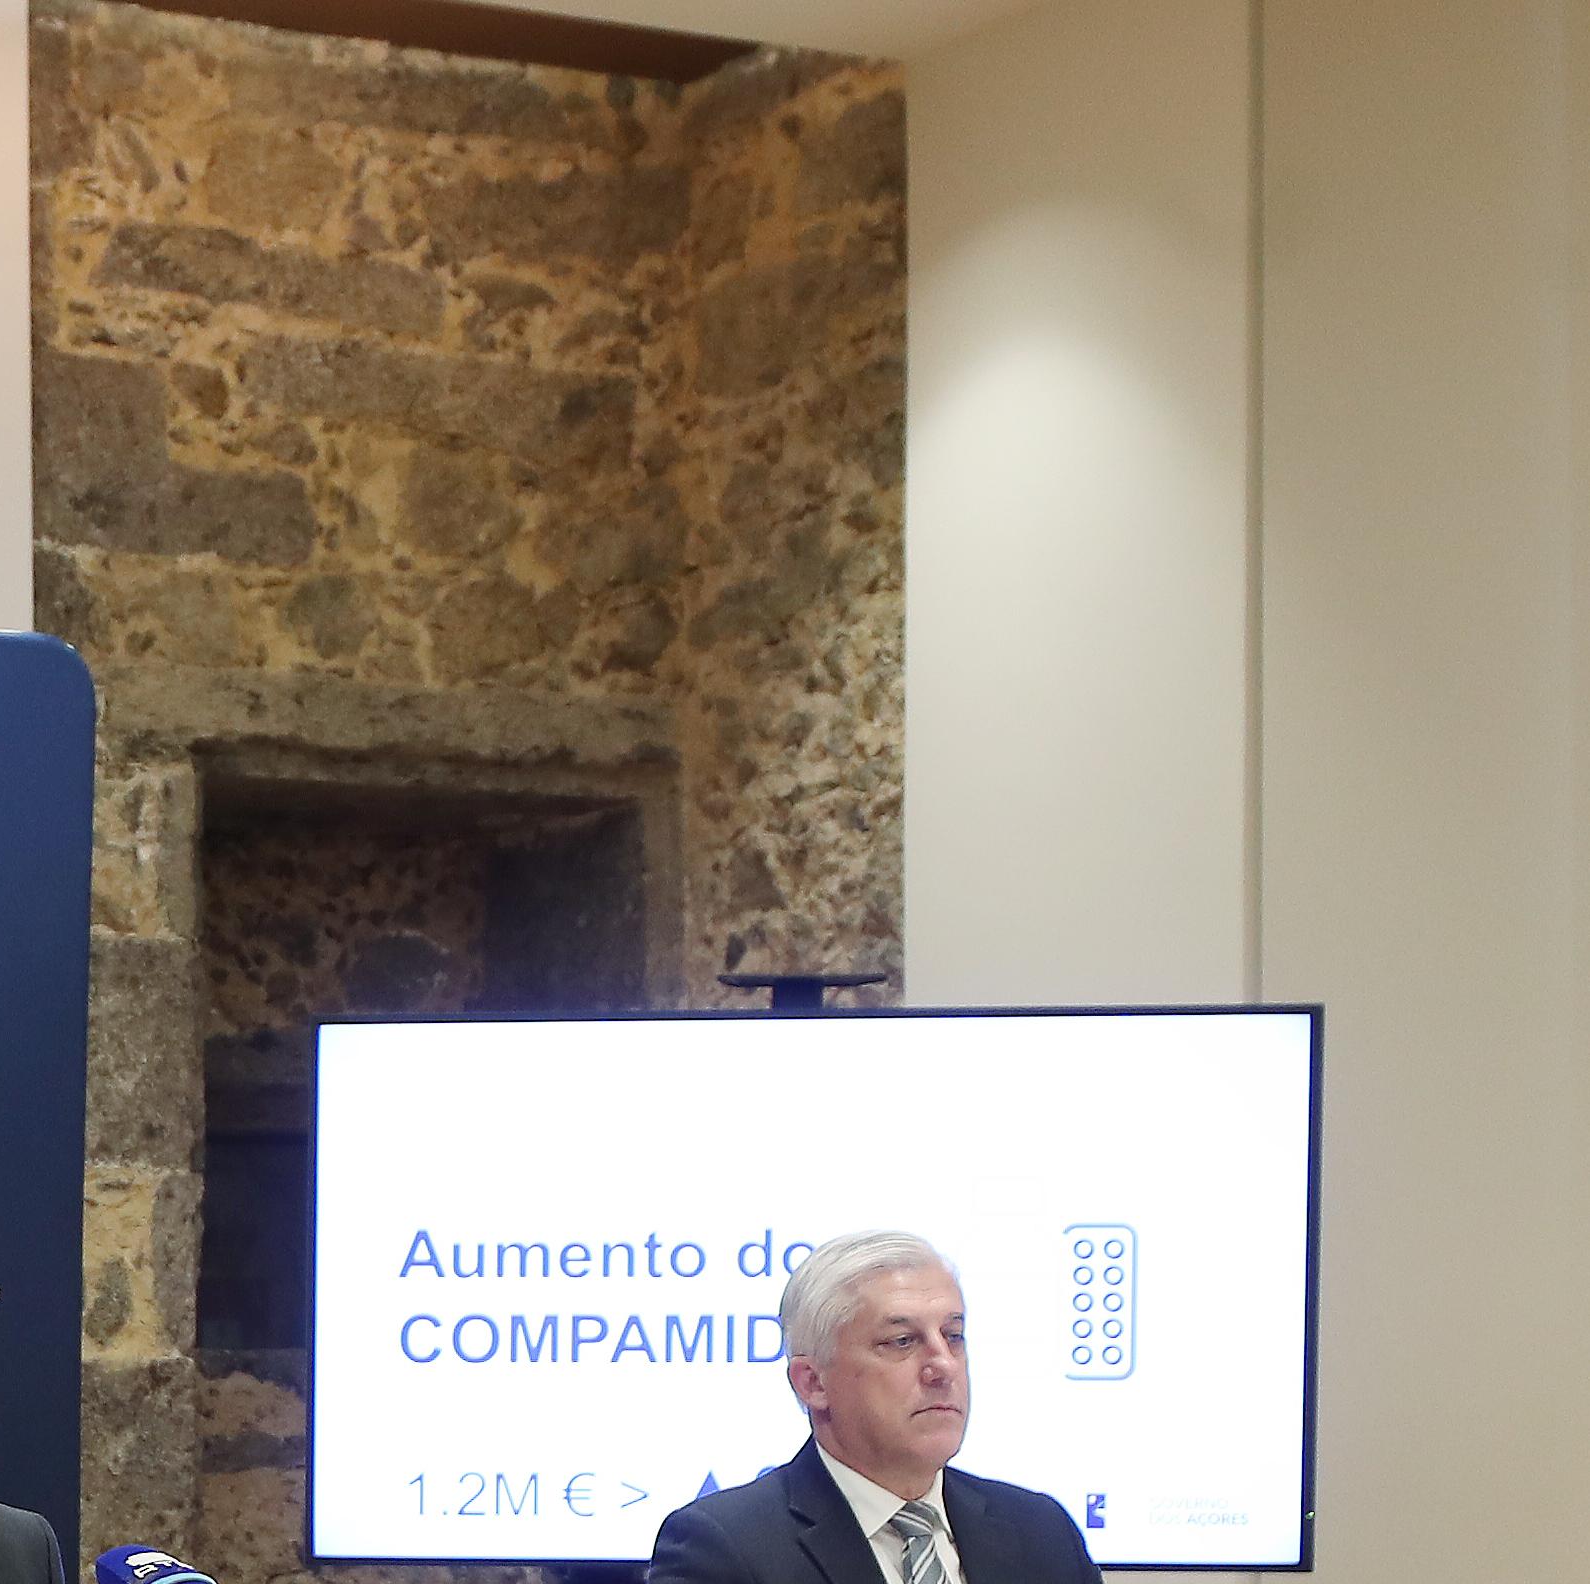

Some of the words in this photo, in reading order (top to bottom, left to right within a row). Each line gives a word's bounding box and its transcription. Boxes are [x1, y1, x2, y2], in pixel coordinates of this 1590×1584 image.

[399, 1228, 707, 1279] Aumento
[400, 1313, 786, 1363] COMPAMID
[408, 1472, 539, 1516] 1.2M
